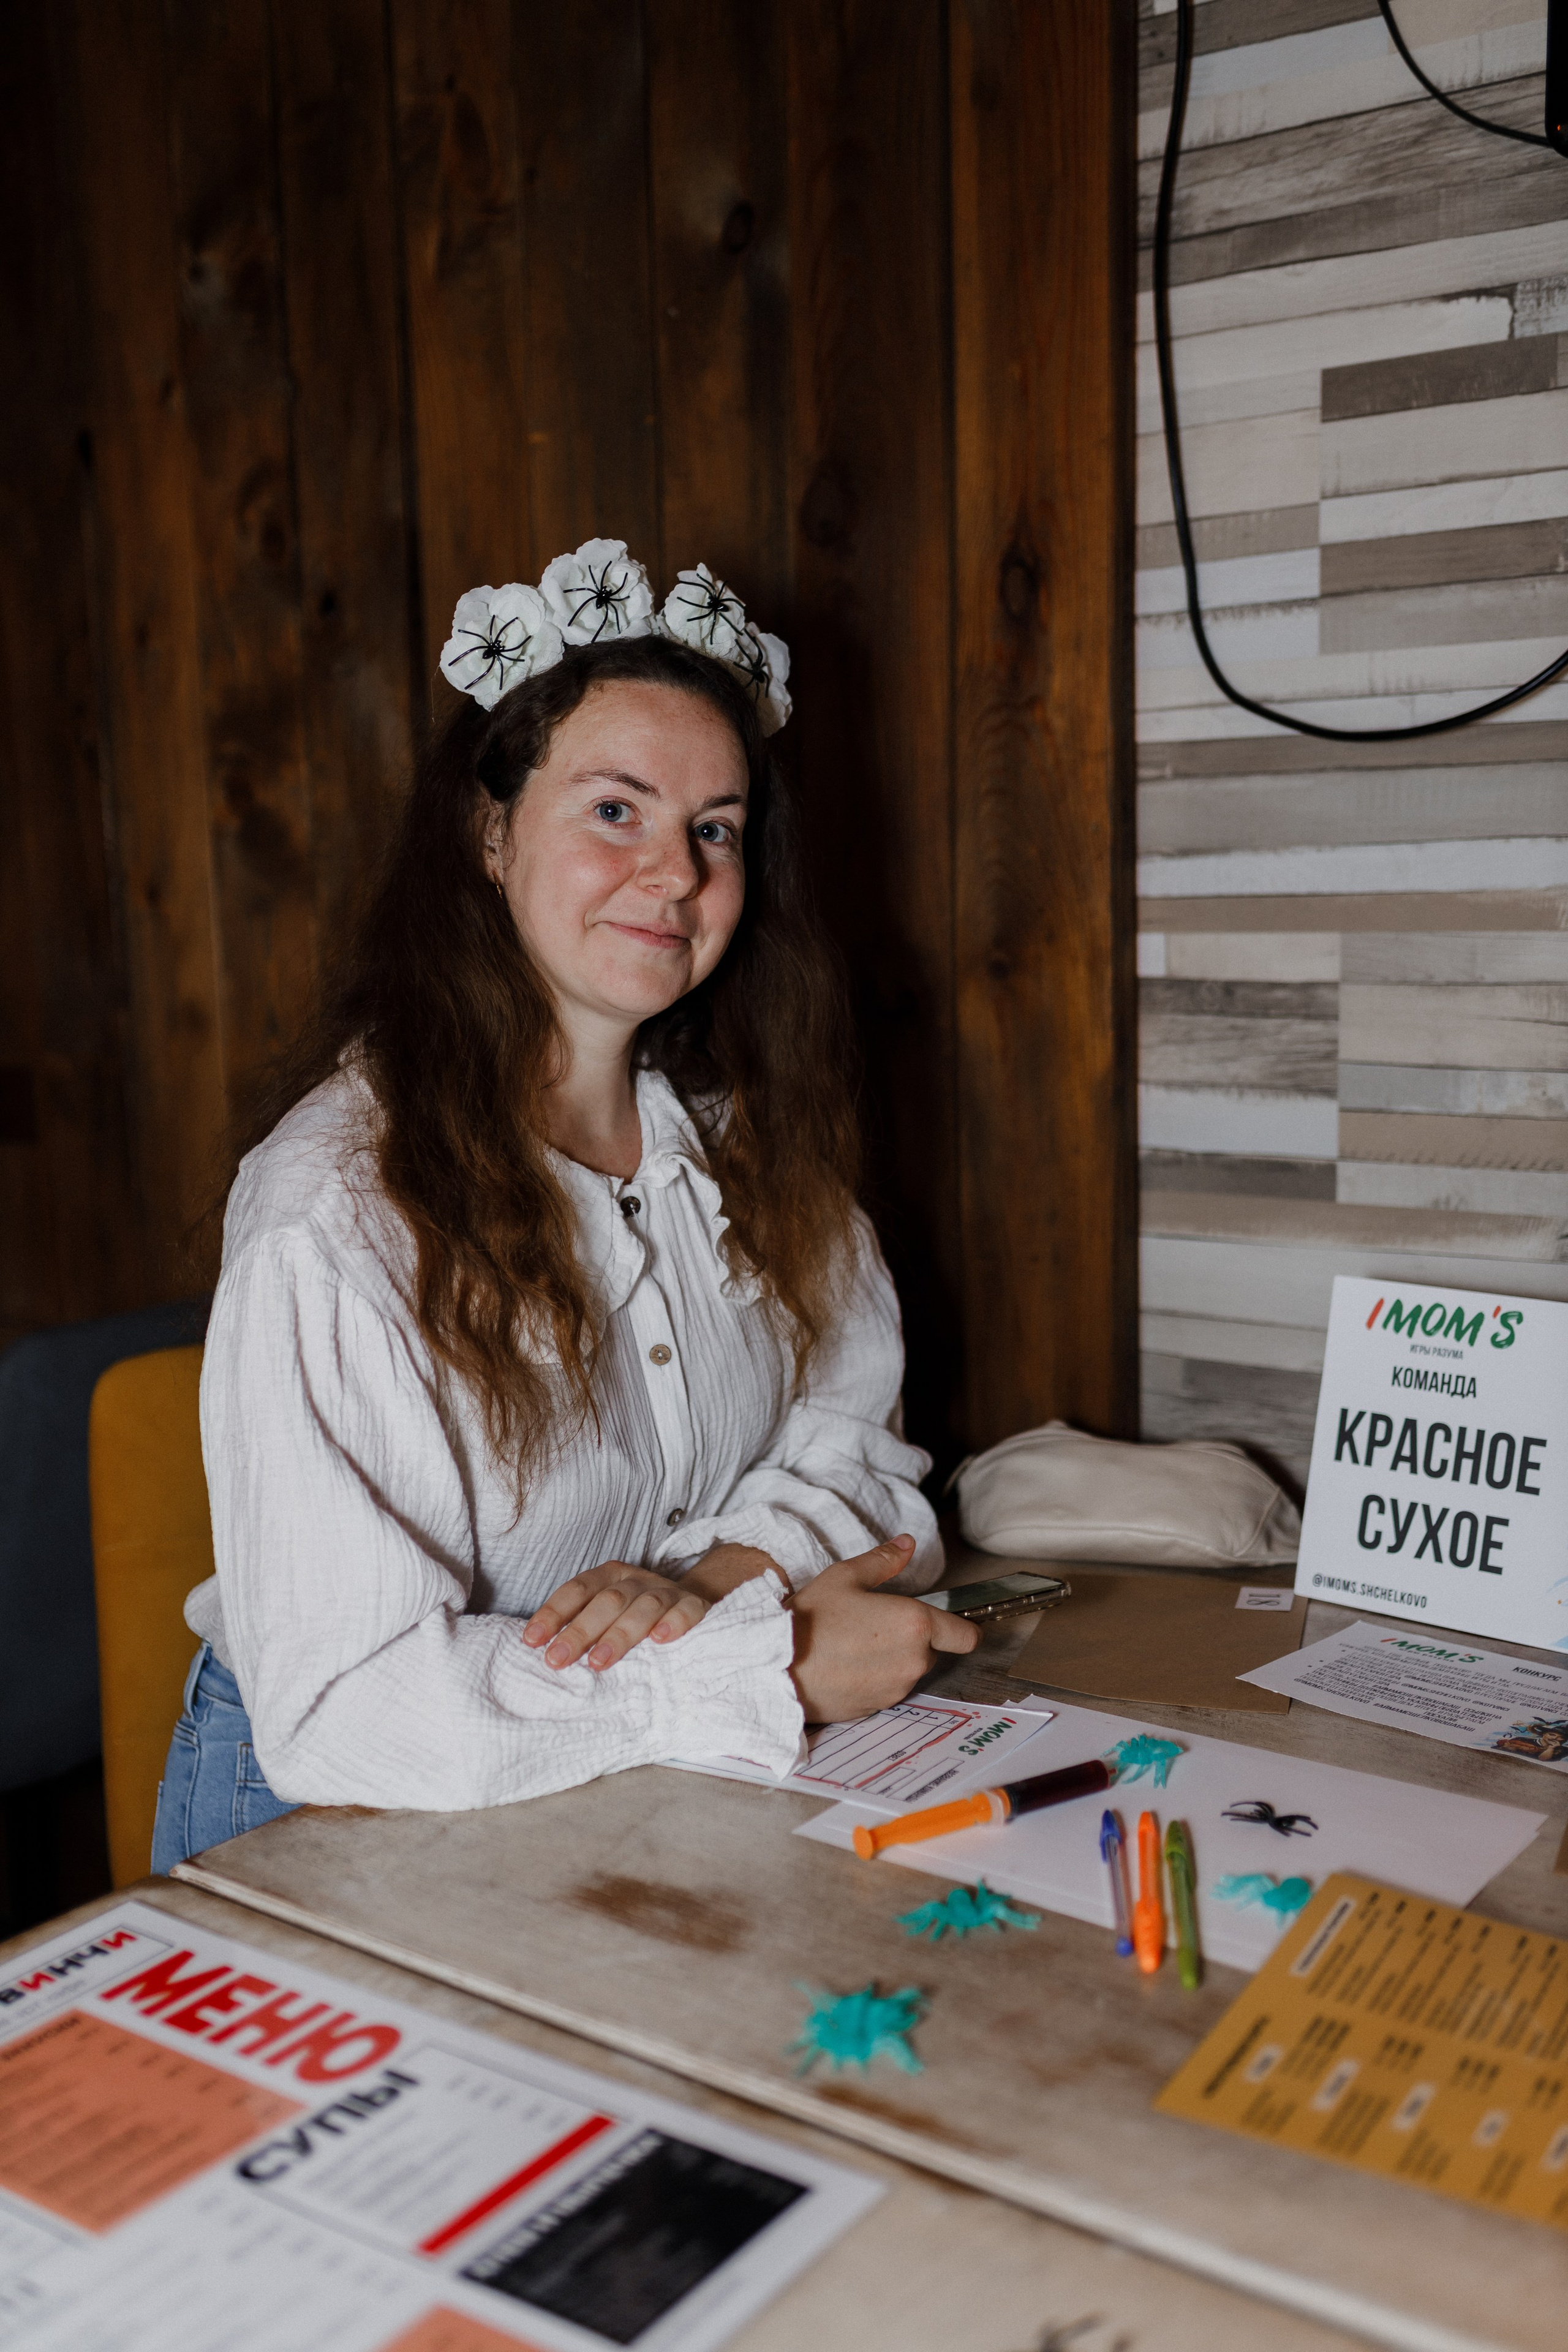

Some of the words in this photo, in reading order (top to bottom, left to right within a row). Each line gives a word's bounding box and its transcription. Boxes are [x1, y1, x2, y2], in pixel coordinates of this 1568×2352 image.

[1409, 1344, 1431, 1358] ИГРЫ
[1433, 1347, 1464, 1360] РАЗУМА
[1390, 1366, 1477, 1398] КОМАНДА
[1333, 1407, 1548, 1496] КРАСНОЕ
[1357, 1493, 1510, 1575] СУХОЕ
[1312, 1573, 1428, 1609] @IMOMS.SHCHELKOVO
[1512, 1667, 1562, 1681] КОНКУРС
[98, 1949, 403, 2086] МЕНЮ
[235, 2068, 421, 2185] СУПЫ
